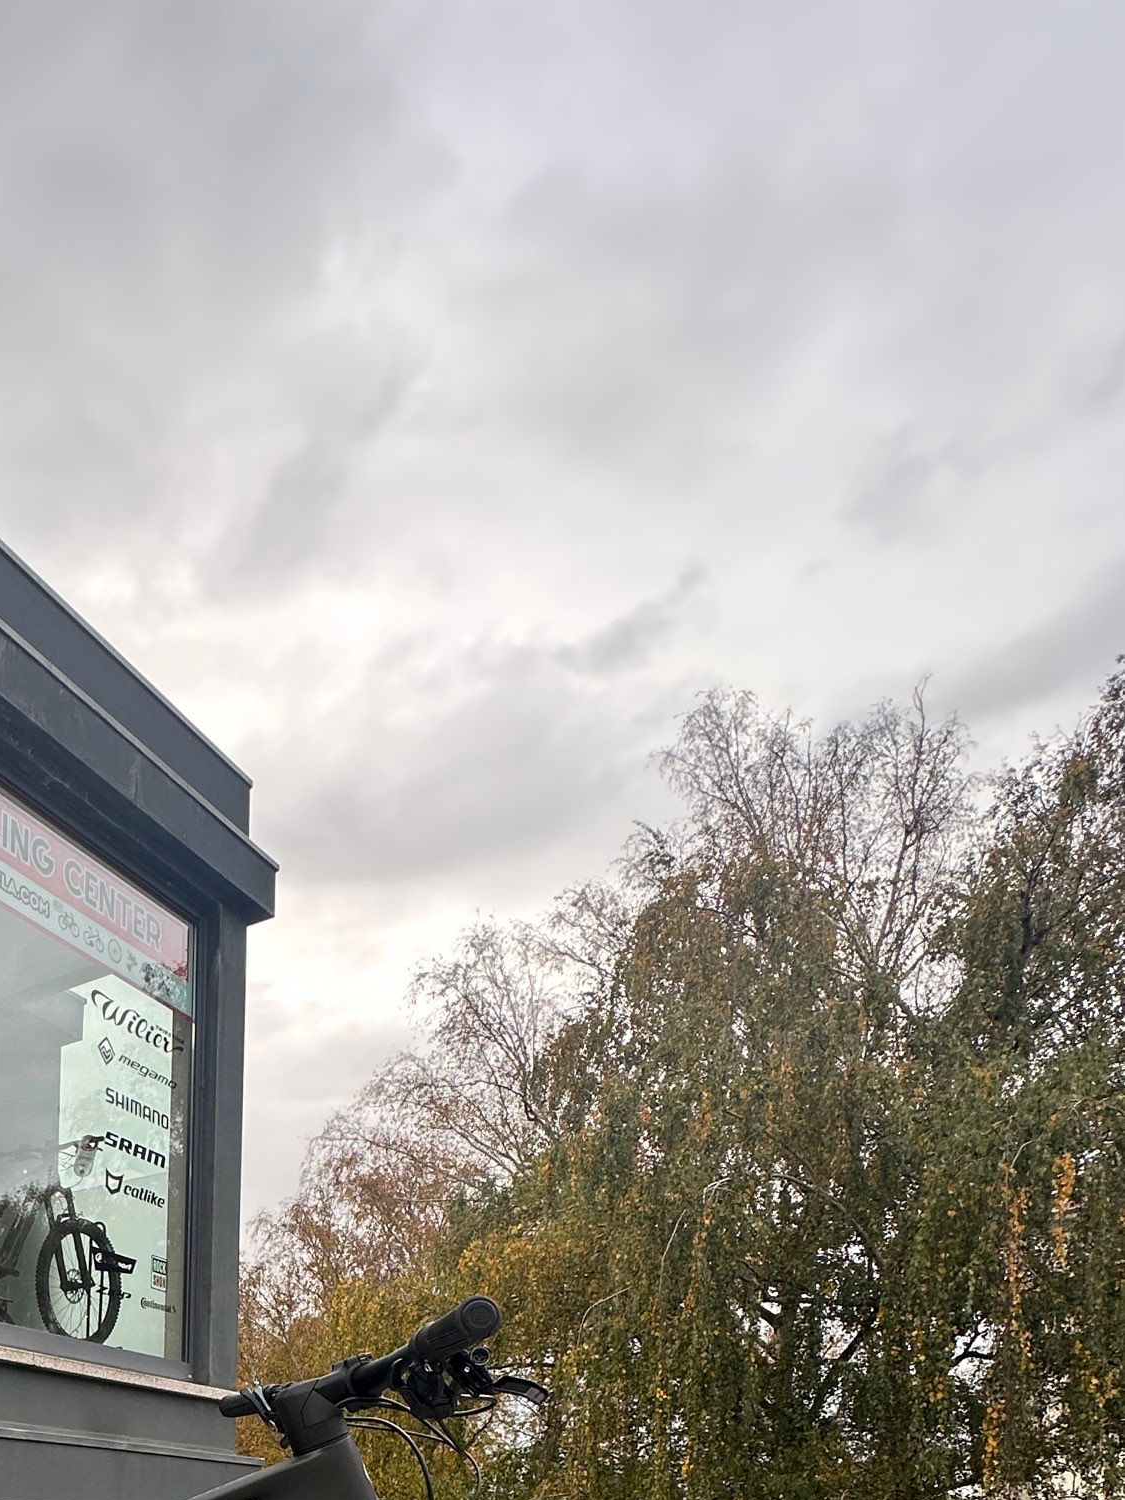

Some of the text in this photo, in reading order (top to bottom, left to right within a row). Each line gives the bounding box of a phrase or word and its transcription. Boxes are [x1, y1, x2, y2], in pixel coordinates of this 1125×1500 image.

[63, 857, 162, 952] CENTER
[91, 989, 185, 1054] Wilier
[118, 1054, 178, 1089] megamo
[105, 1086, 170, 1130] SHIMANO
[104, 1131, 166, 1169] SRAM
[123, 1184, 165, 1209] catlike
